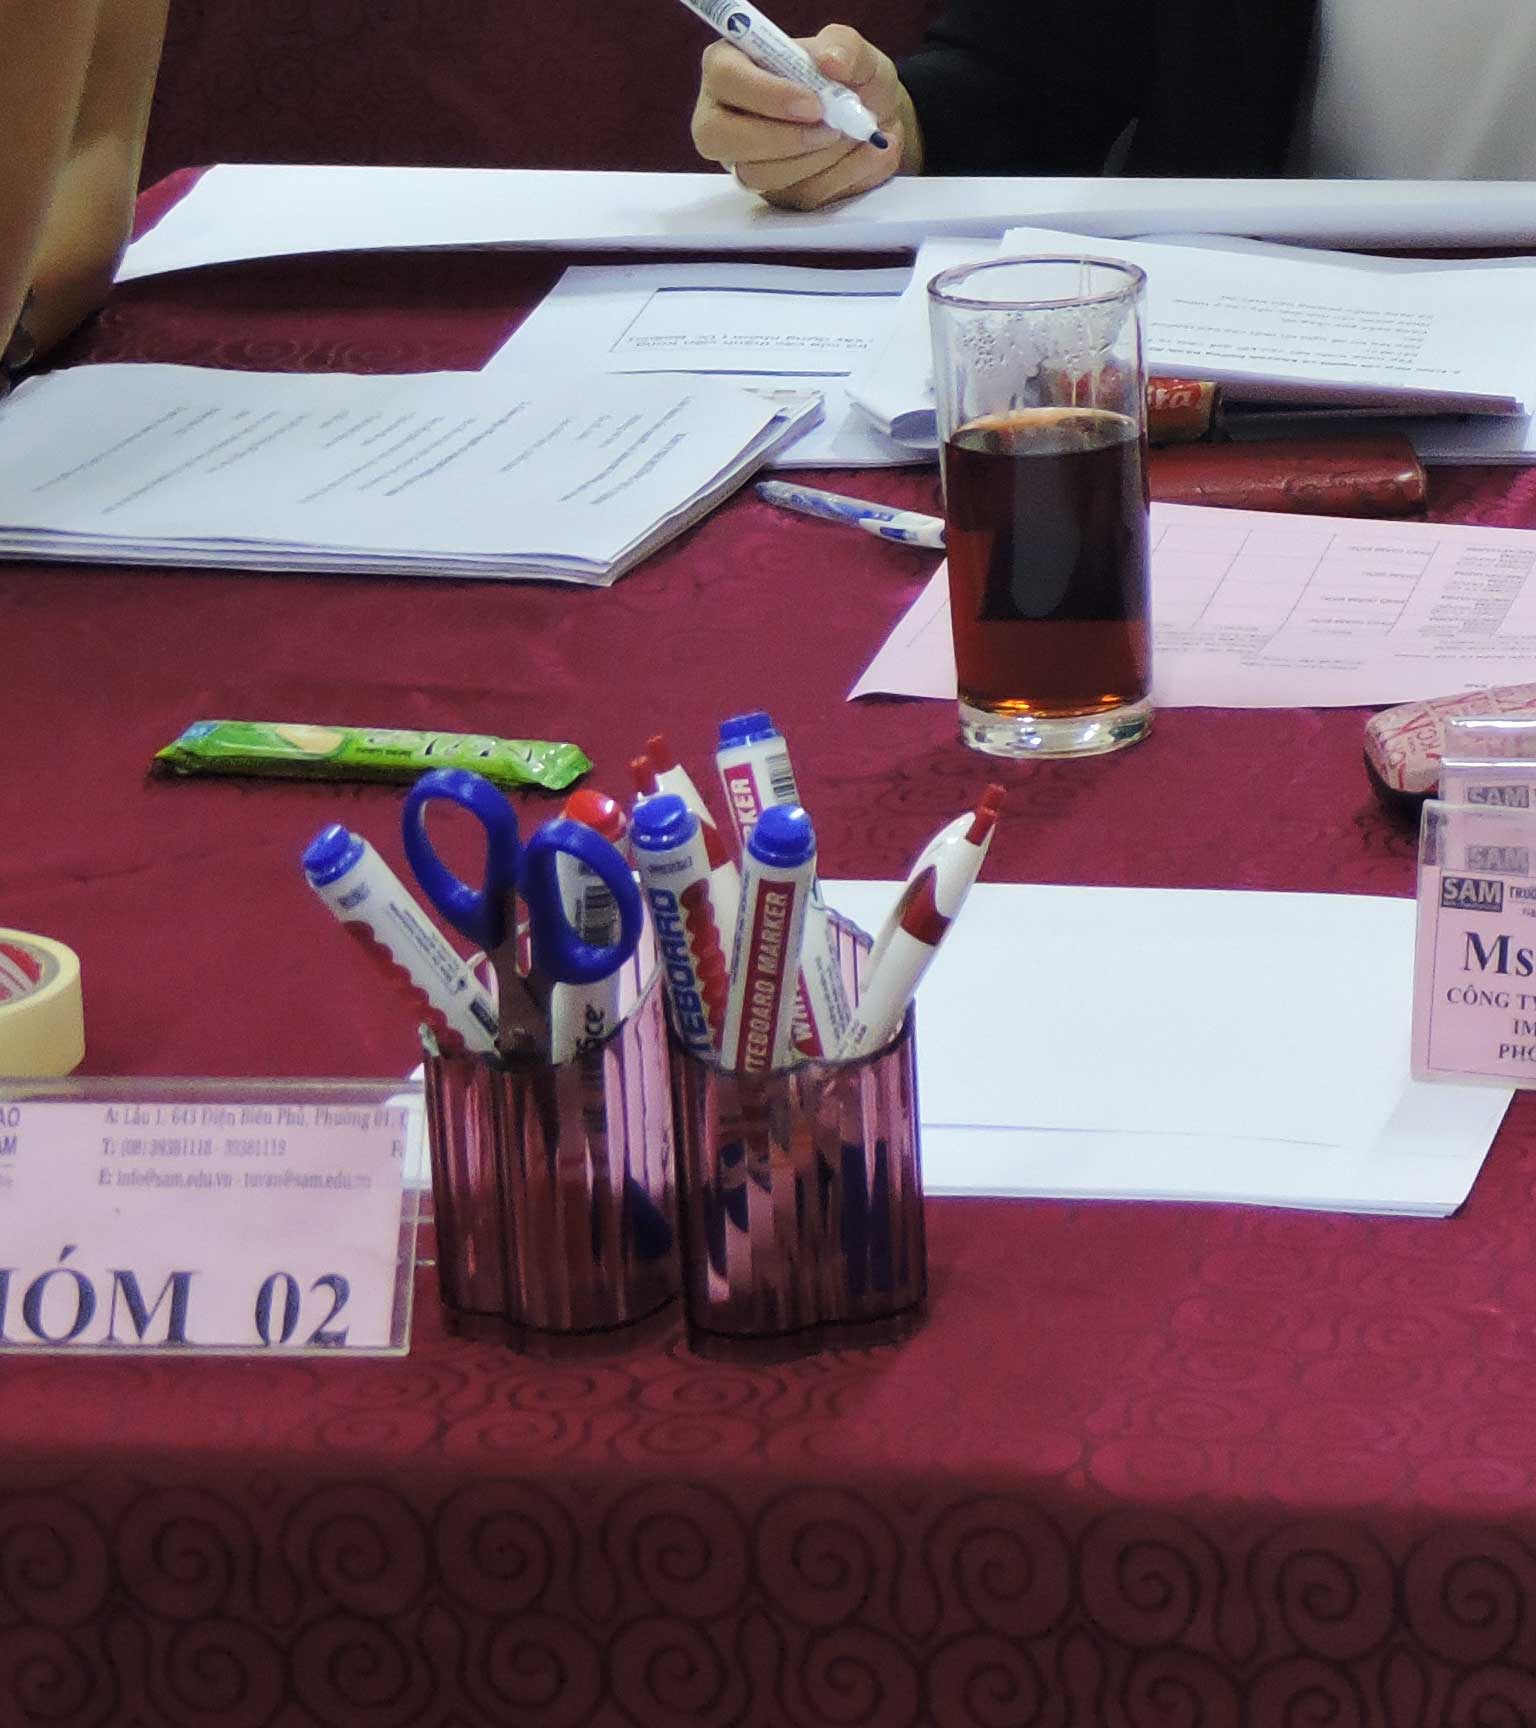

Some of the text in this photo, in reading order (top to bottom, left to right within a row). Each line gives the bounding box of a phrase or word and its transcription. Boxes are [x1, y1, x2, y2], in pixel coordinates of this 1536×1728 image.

[1442, 876, 1503, 906] SAM
[1463, 931, 1535, 978] Ms
[1446, 983, 1510, 1010] CÔNG
[254, 1270, 352, 1347] 02
